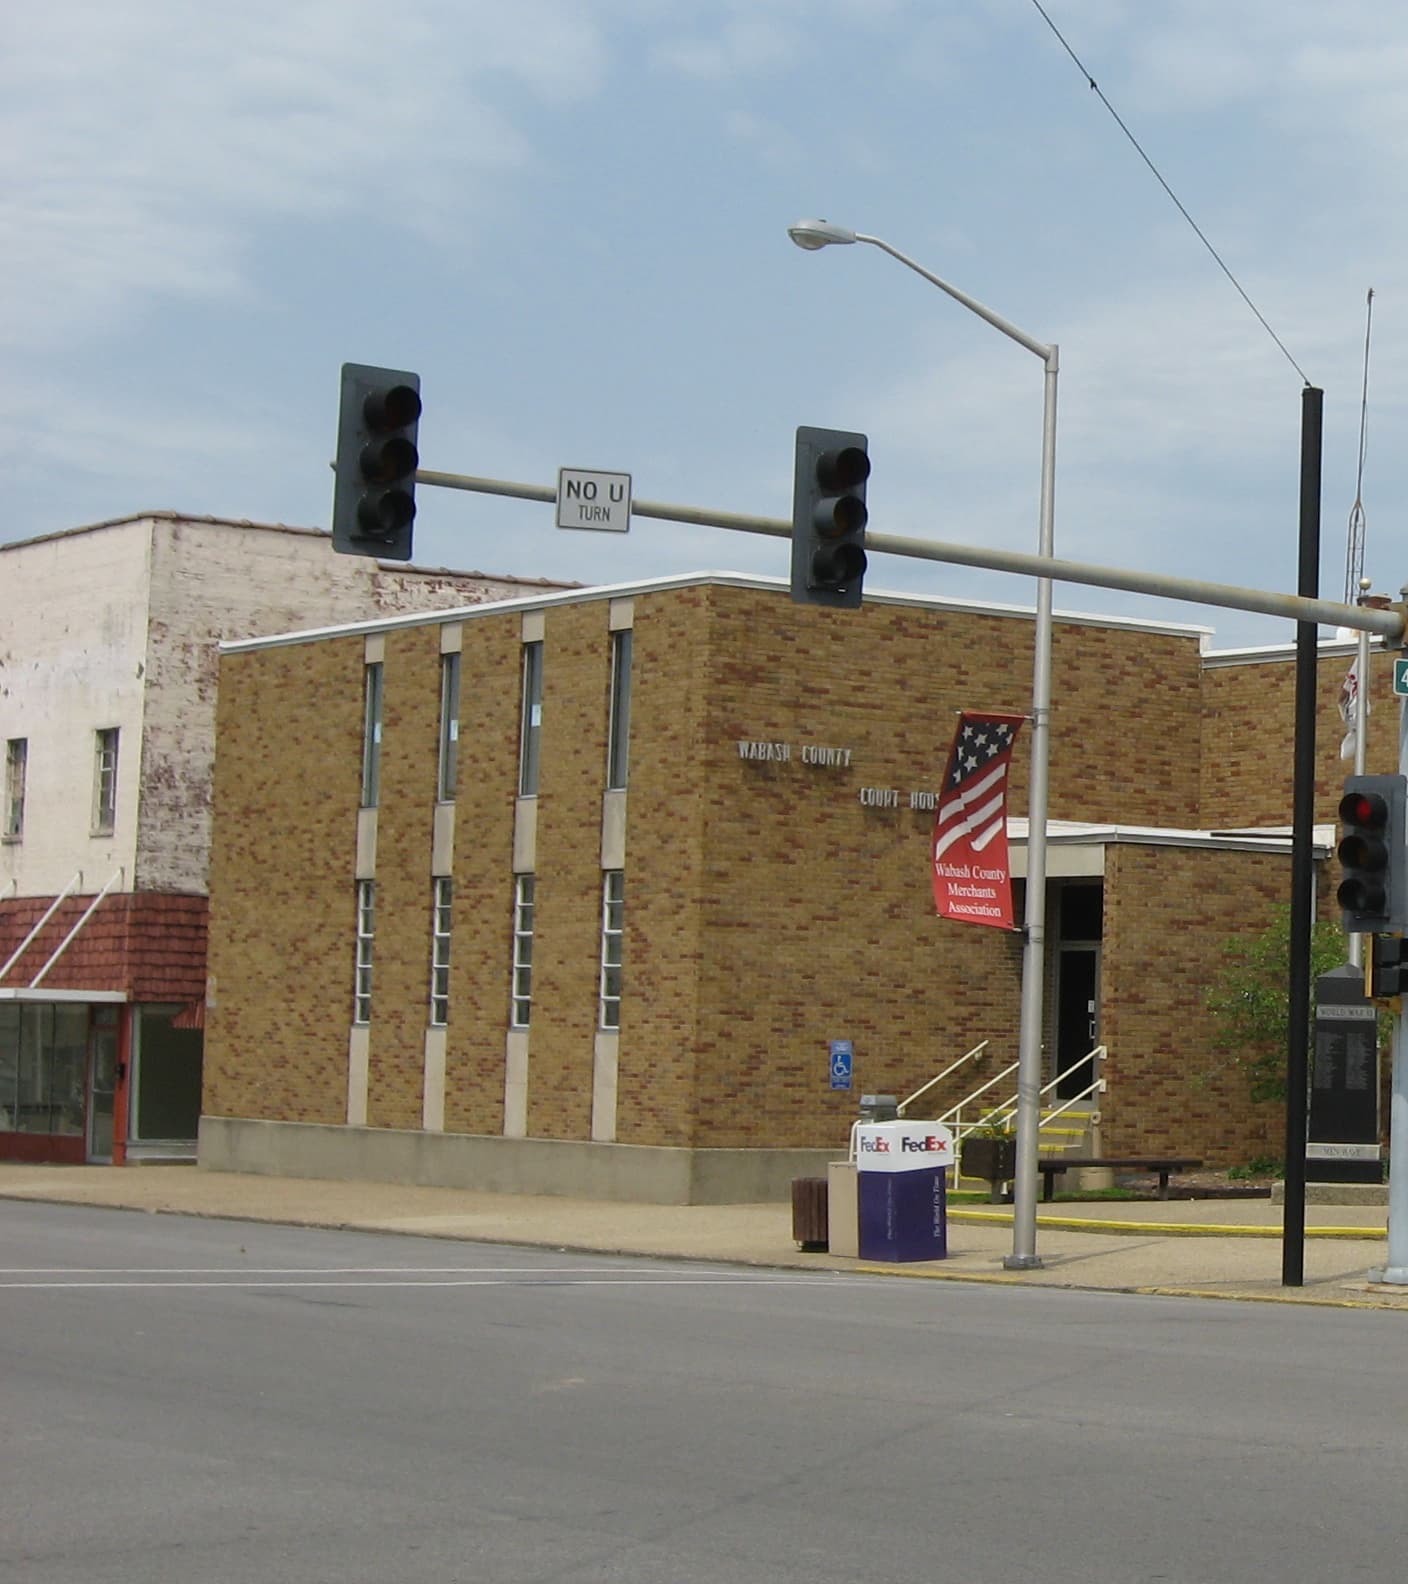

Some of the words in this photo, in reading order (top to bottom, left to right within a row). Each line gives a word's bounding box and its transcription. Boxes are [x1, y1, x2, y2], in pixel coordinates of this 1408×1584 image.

[567, 480, 597, 500] NO
[610, 484, 623, 502] U
[579, 504, 610, 521] TURN
[737, 741, 790, 761] WABASH
[802, 746, 850, 767] COUNTY
[860, 788, 899, 808] COURT
[935, 863, 970, 878] Wabash
[972, 866, 1006, 883] County
[948, 883, 997, 898] Merchants
[949, 901, 1001, 917] Association
[861, 1136, 889, 1152] FedEx
[902, 1136, 946, 1152] FedEx
